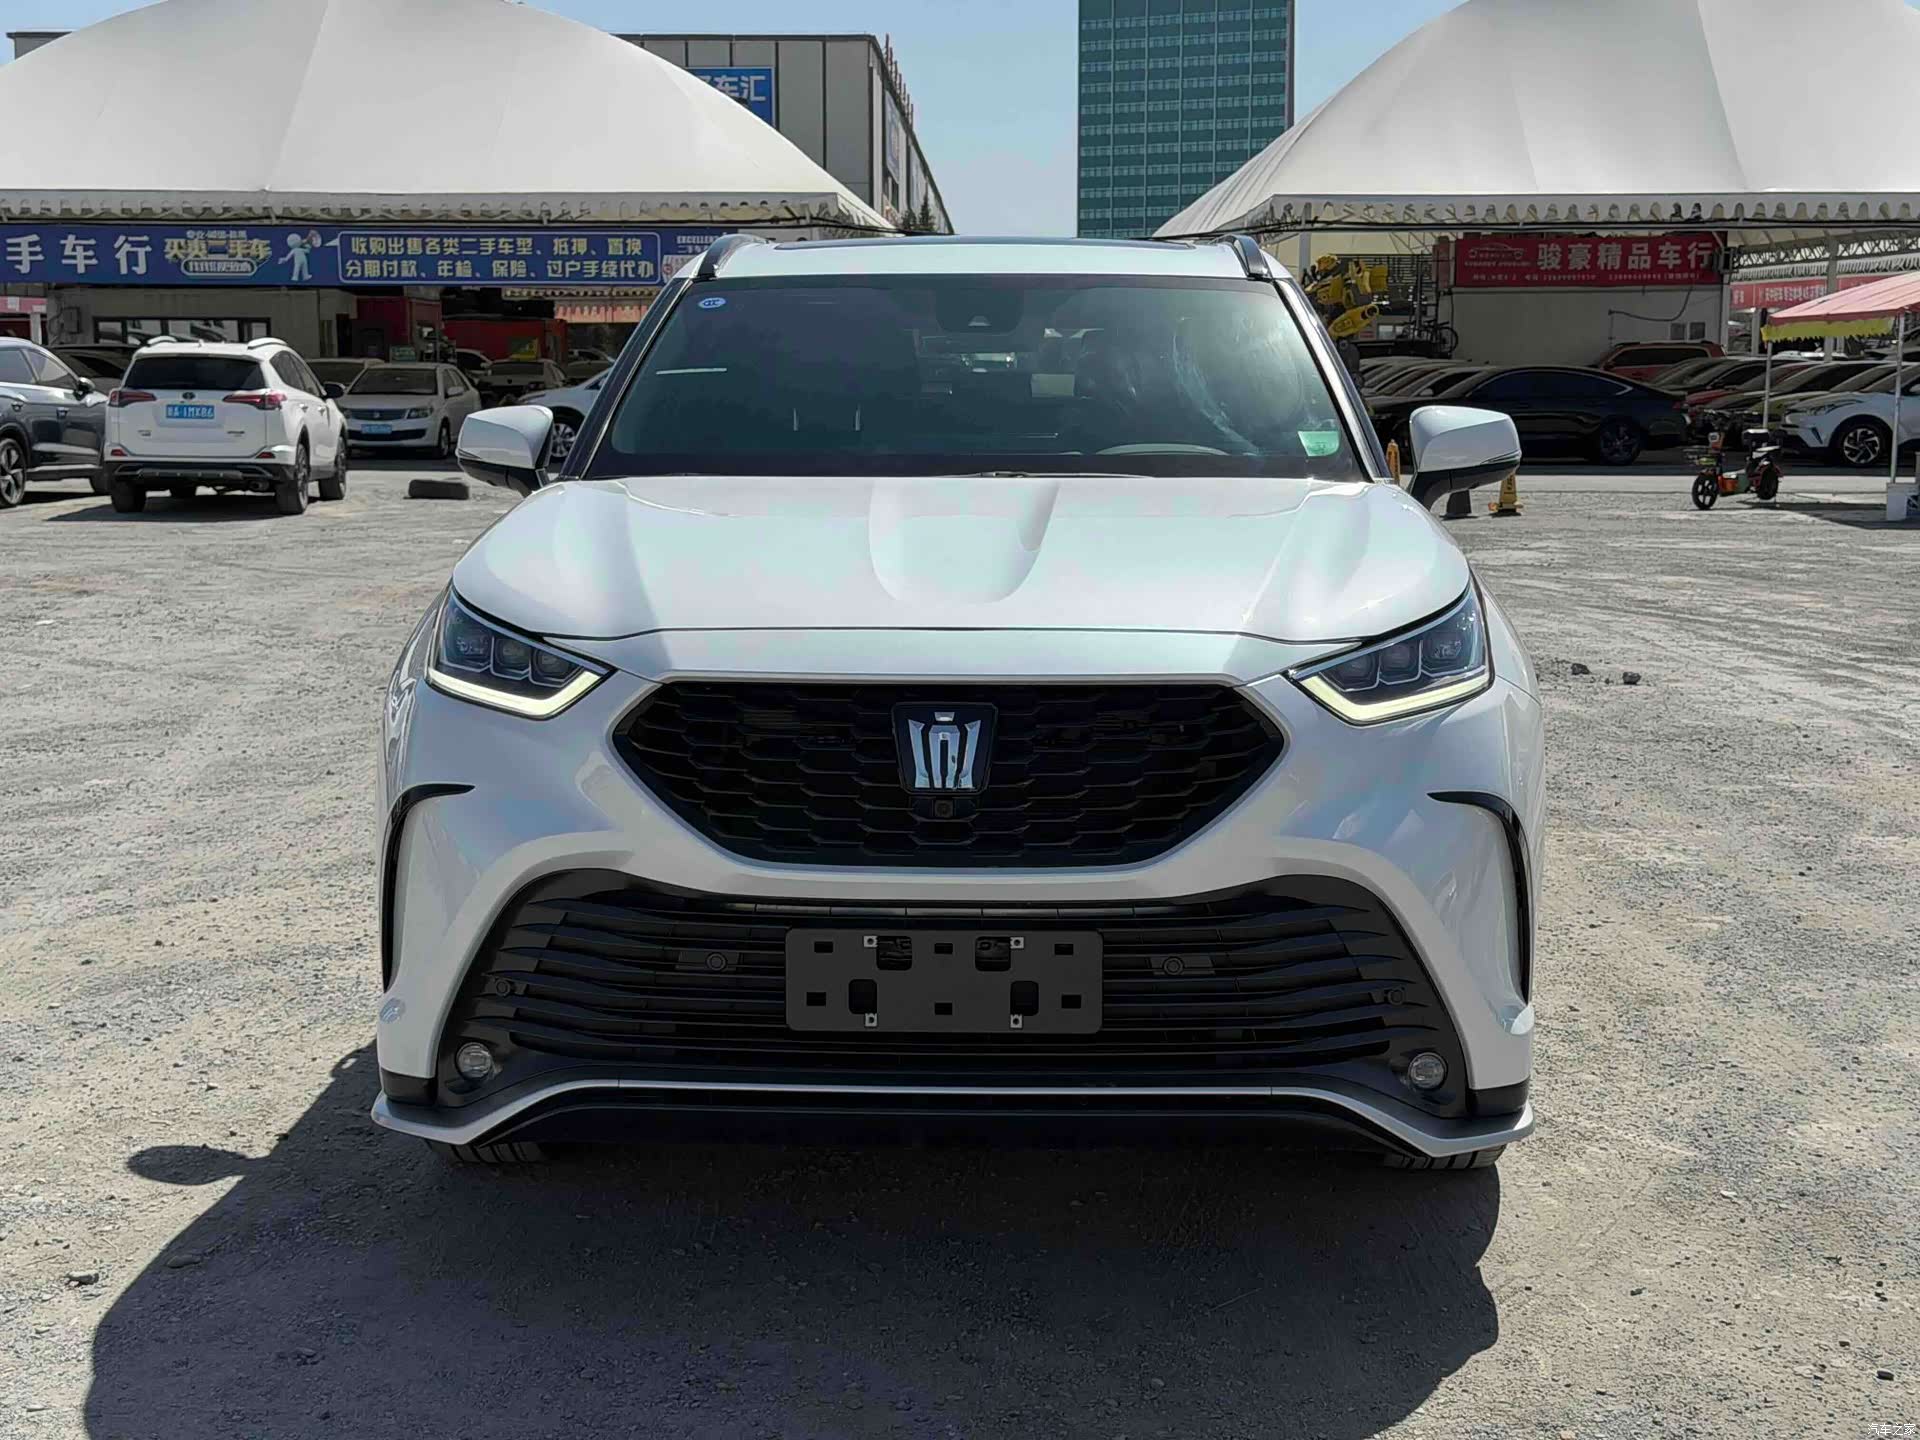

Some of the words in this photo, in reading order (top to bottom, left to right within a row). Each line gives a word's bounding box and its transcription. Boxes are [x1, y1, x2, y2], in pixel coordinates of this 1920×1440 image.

[698, 75, 766, 101] 车汇
[5, 233, 152, 275] 手车行
[1536, 241, 1713, 270] 骏豪精品车行
